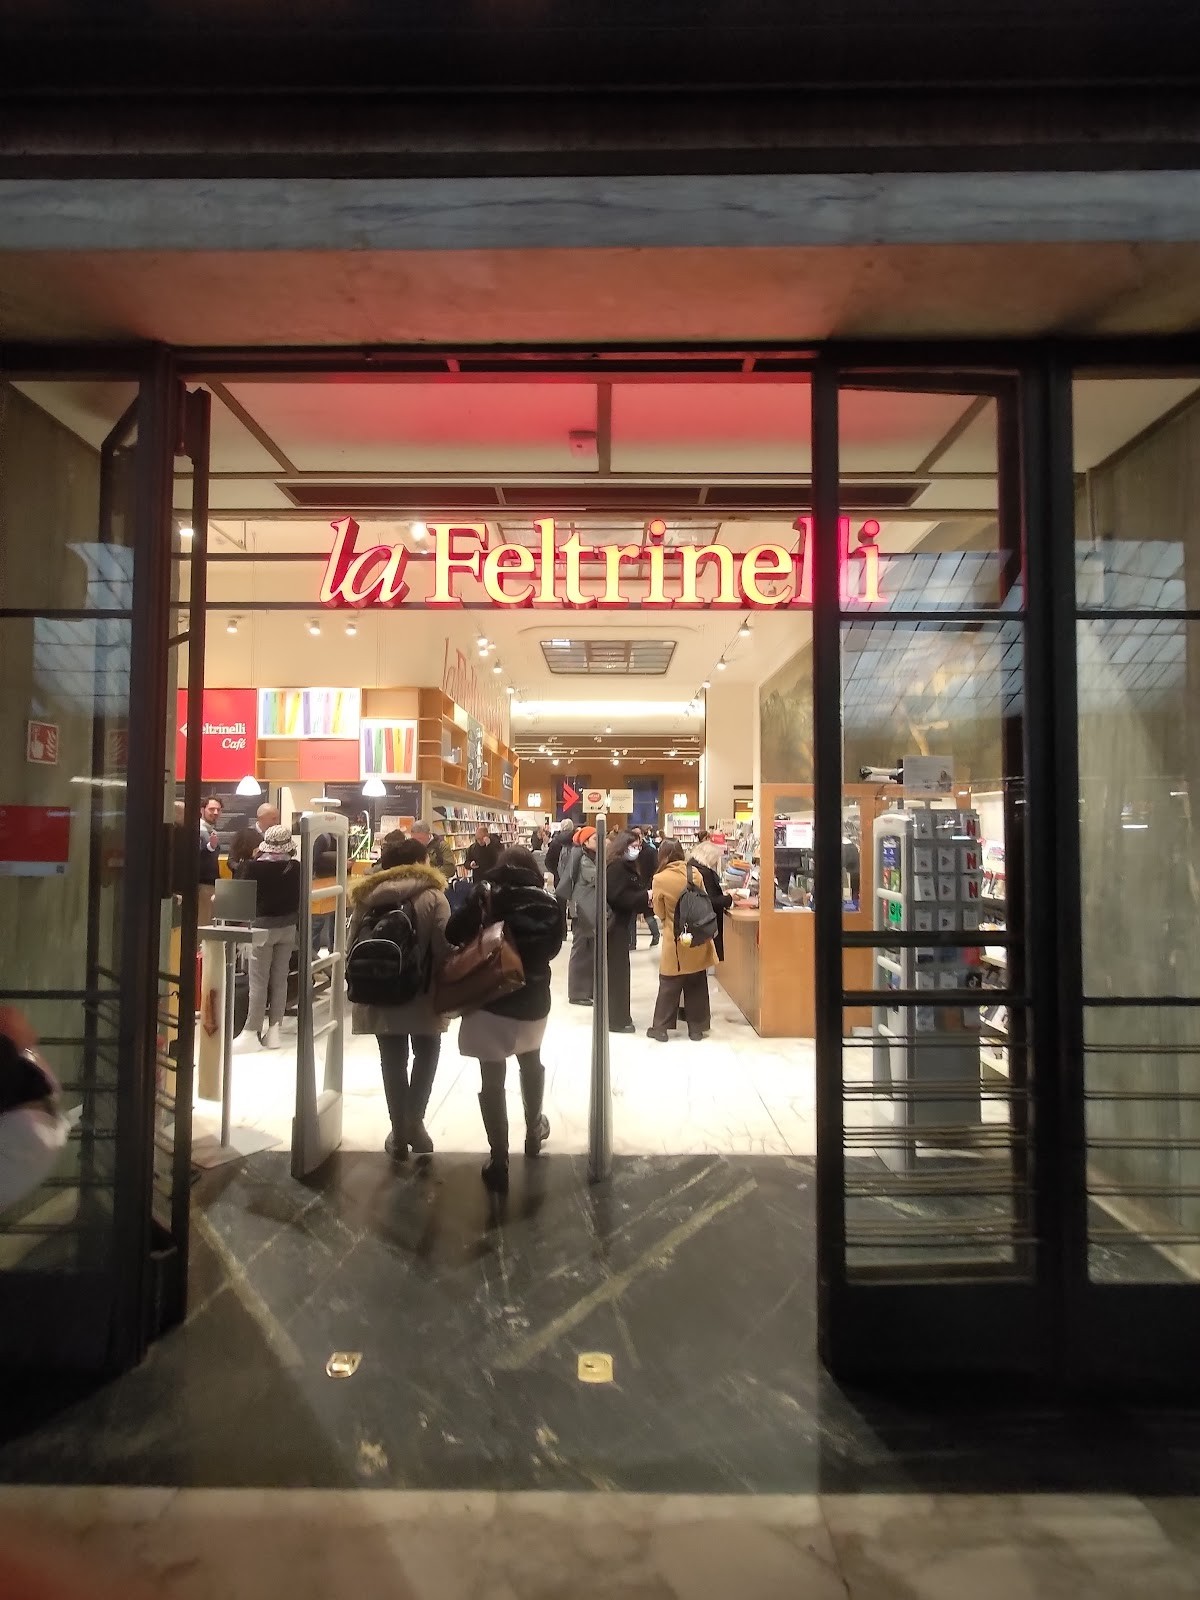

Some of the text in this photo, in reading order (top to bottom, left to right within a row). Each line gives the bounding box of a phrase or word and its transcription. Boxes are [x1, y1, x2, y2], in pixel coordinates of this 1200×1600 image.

[319, 516, 884, 606] la Feltrinelli
[202, 722, 246, 735] eltrinelli
[221, 738, 246, 751] Café
[966, 852, 977, 870] N
[968, 881, 979, 899] N
